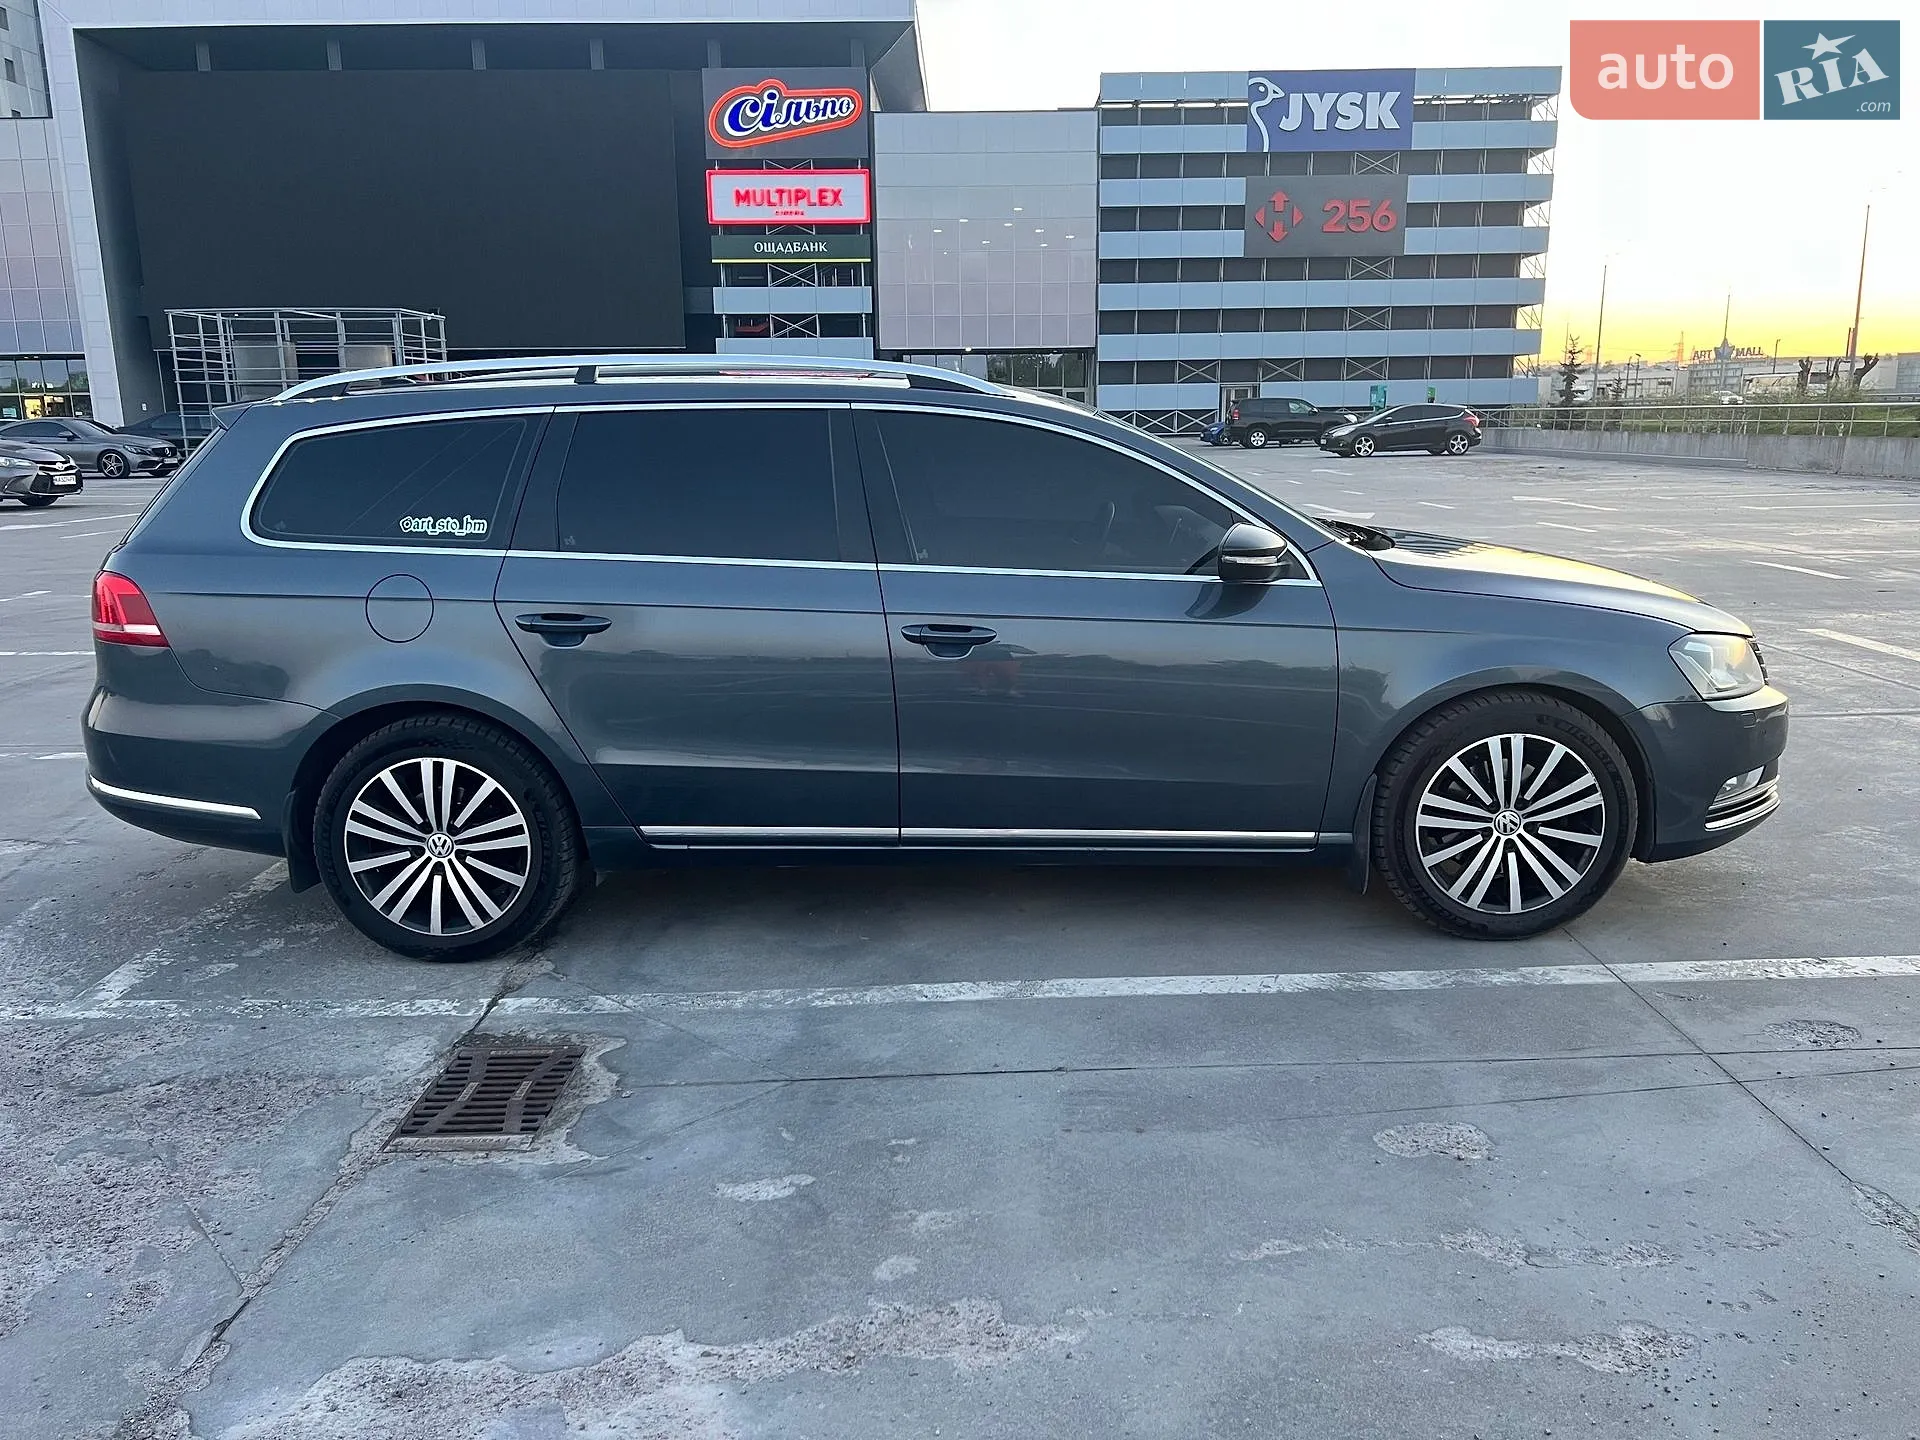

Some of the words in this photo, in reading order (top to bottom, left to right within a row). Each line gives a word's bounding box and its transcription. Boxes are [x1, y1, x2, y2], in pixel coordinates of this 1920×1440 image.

[726, 91, 854, 134] Сільпо
[1279, 91, 1401, 131] JYSK
[733, 188, 843, 207] MULTIPLEX
[1322, 199, 1398, 232] 256
[754, 241, 828, 254] ОЩАДБАНК
[1693, 350, 1713, 360] ART
[1735, 347, 1764, 357] MALL
